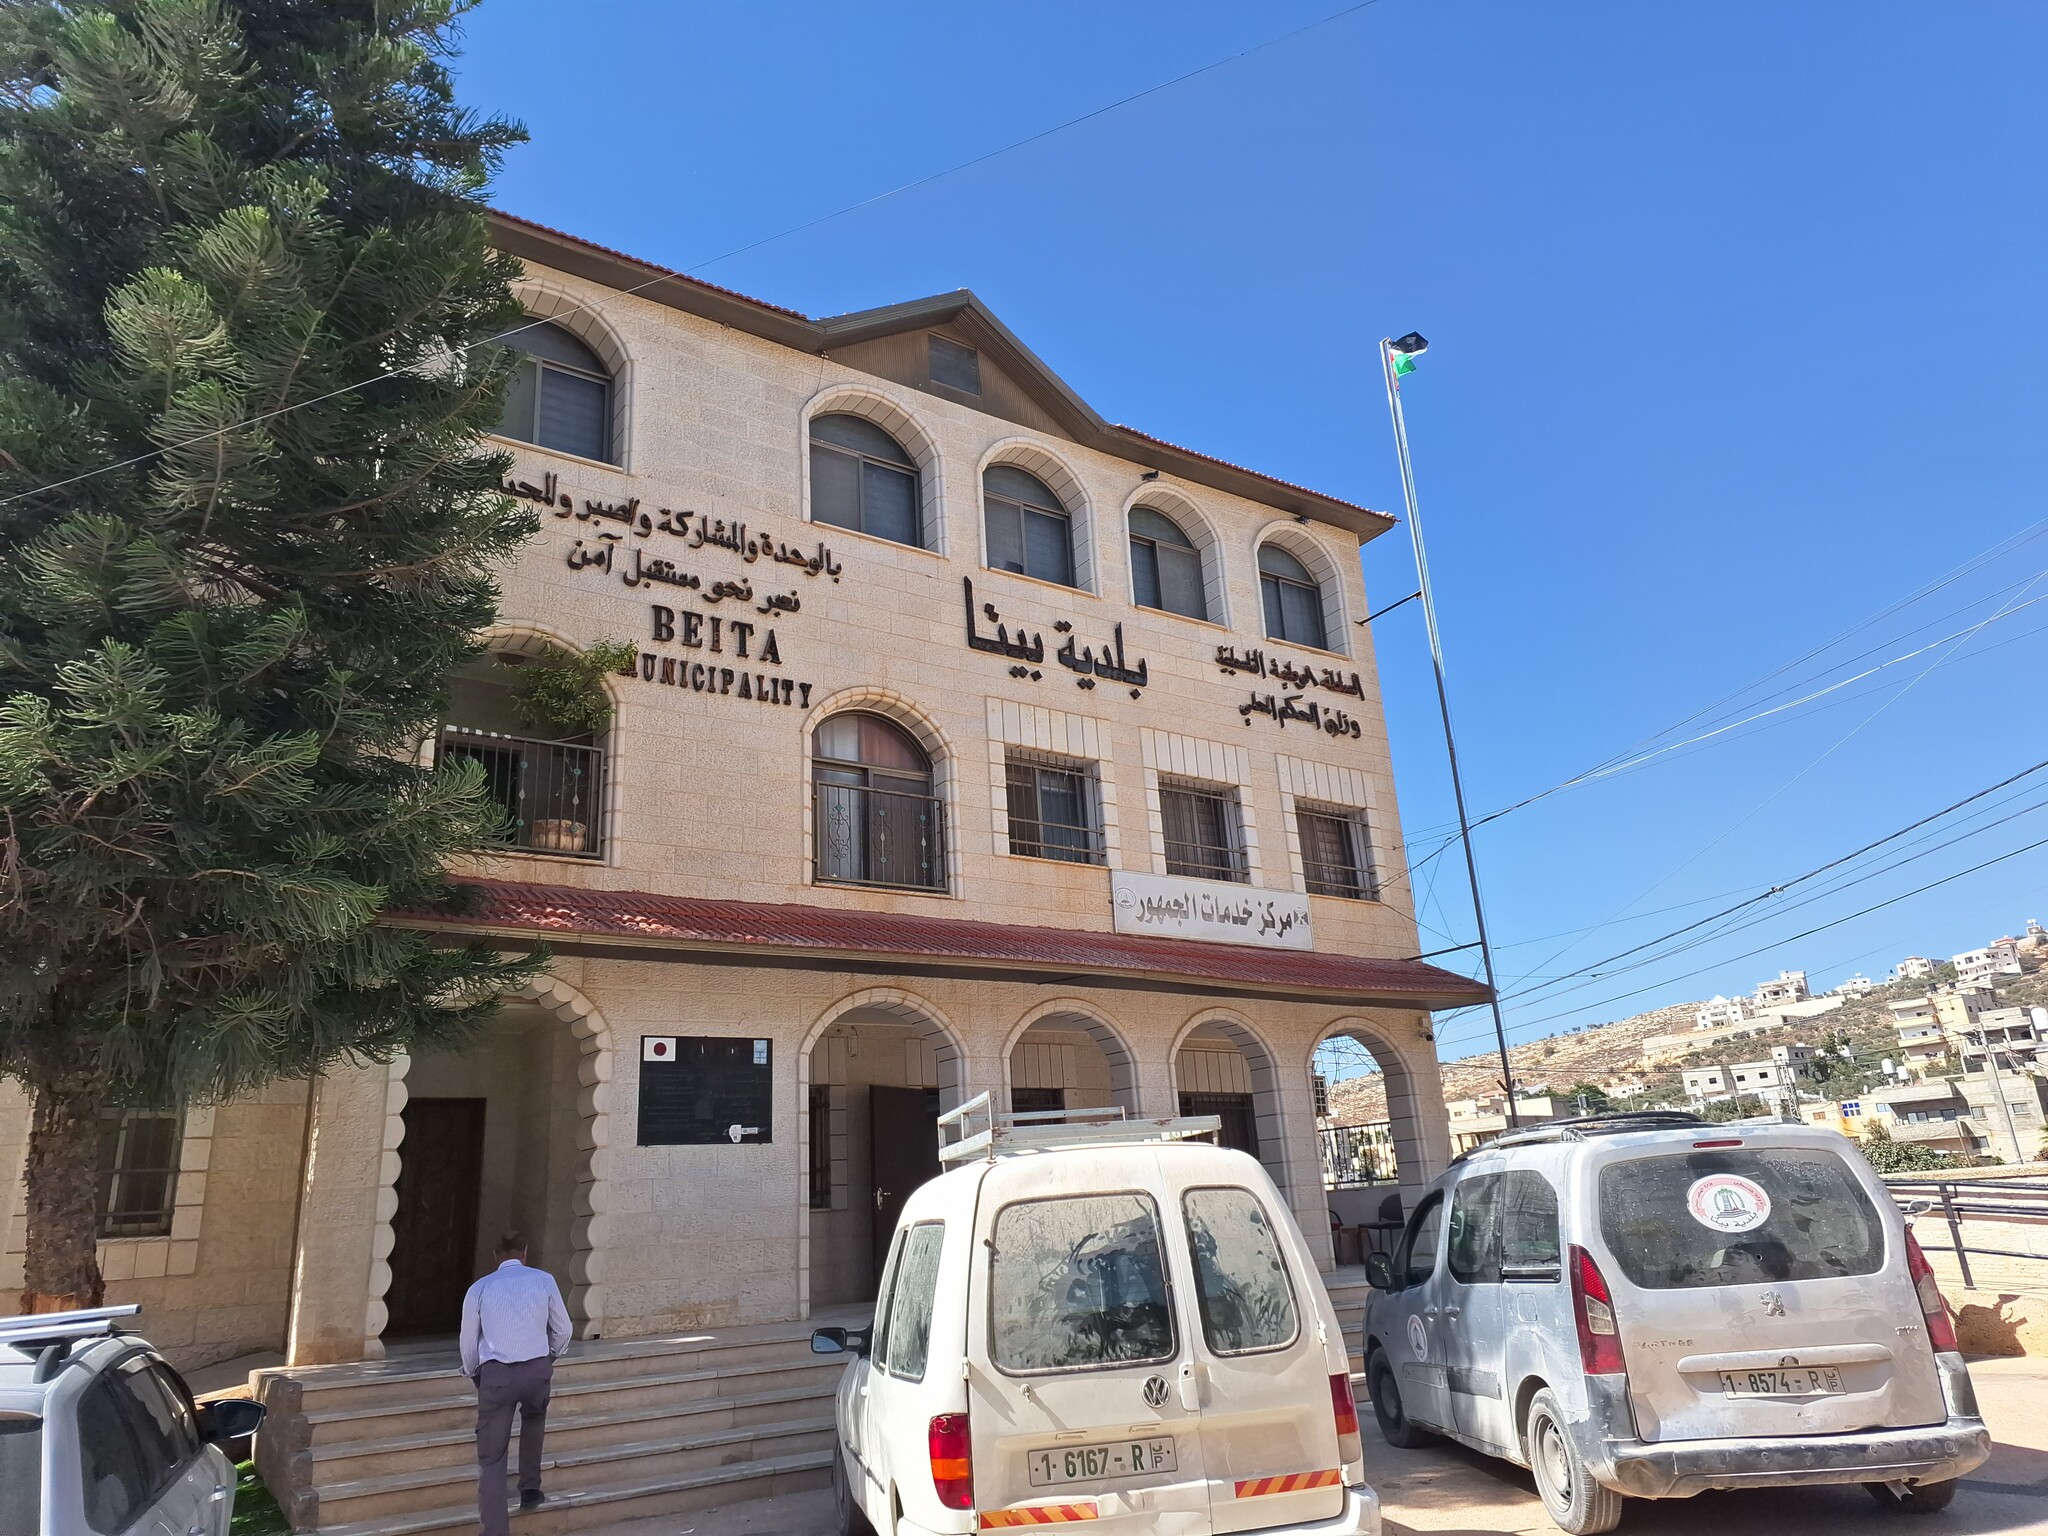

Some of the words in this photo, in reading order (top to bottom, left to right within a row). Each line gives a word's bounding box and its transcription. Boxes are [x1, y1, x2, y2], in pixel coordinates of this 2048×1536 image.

[576, 497, 652, 538] والصبر
[657, 508, 759, 563] والمشاركة
[567, 532, 623, 575] آمن
[623, 548, 701, 590] مستقبل
[760, 532, 842, 584] بالوحدة
[702, 578, 754, 603] نحو
[651, 604, 783, 665] BEITA
[963, 575, 1044, 682] بيتا
[1054, 618, 1148, 700] بلدية
[1136, 892, 1197, 927] الجمهور
[1201, 893, 1252, 926] خدمات
[1257, 900, 1292, 938] مركز
[1710, 1215, 1730, 1228] بيتا
[1733, 1212, 1759, 1228] بلدية
[1154, 1455, 1163, 1469] P
